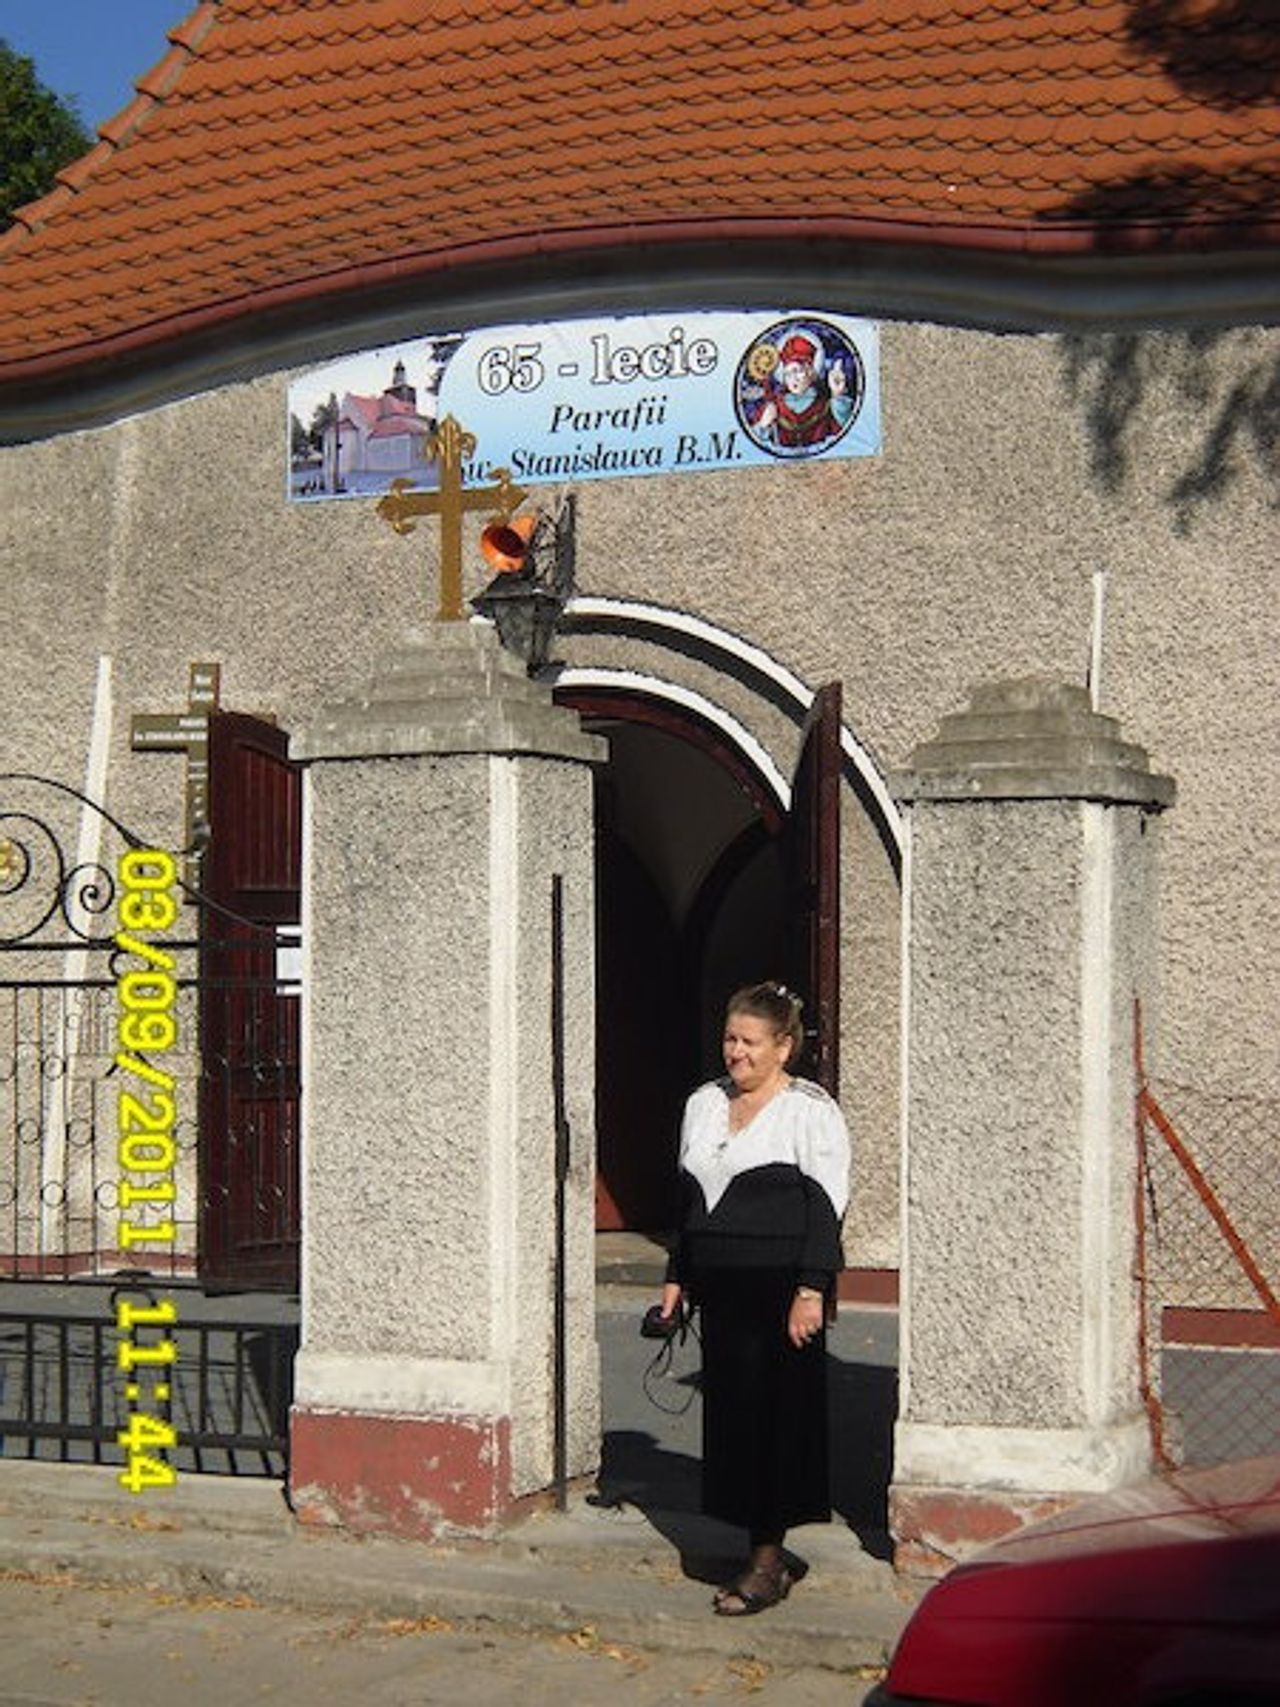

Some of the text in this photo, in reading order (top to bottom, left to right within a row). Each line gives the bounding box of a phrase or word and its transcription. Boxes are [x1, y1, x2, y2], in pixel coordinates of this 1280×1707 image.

[478, 342, 545, 396] 65
[590, 326, 718, 385] lecie
[549, 395, 667, 434] Parafii
[674, 429, 743, 465] B.M.
